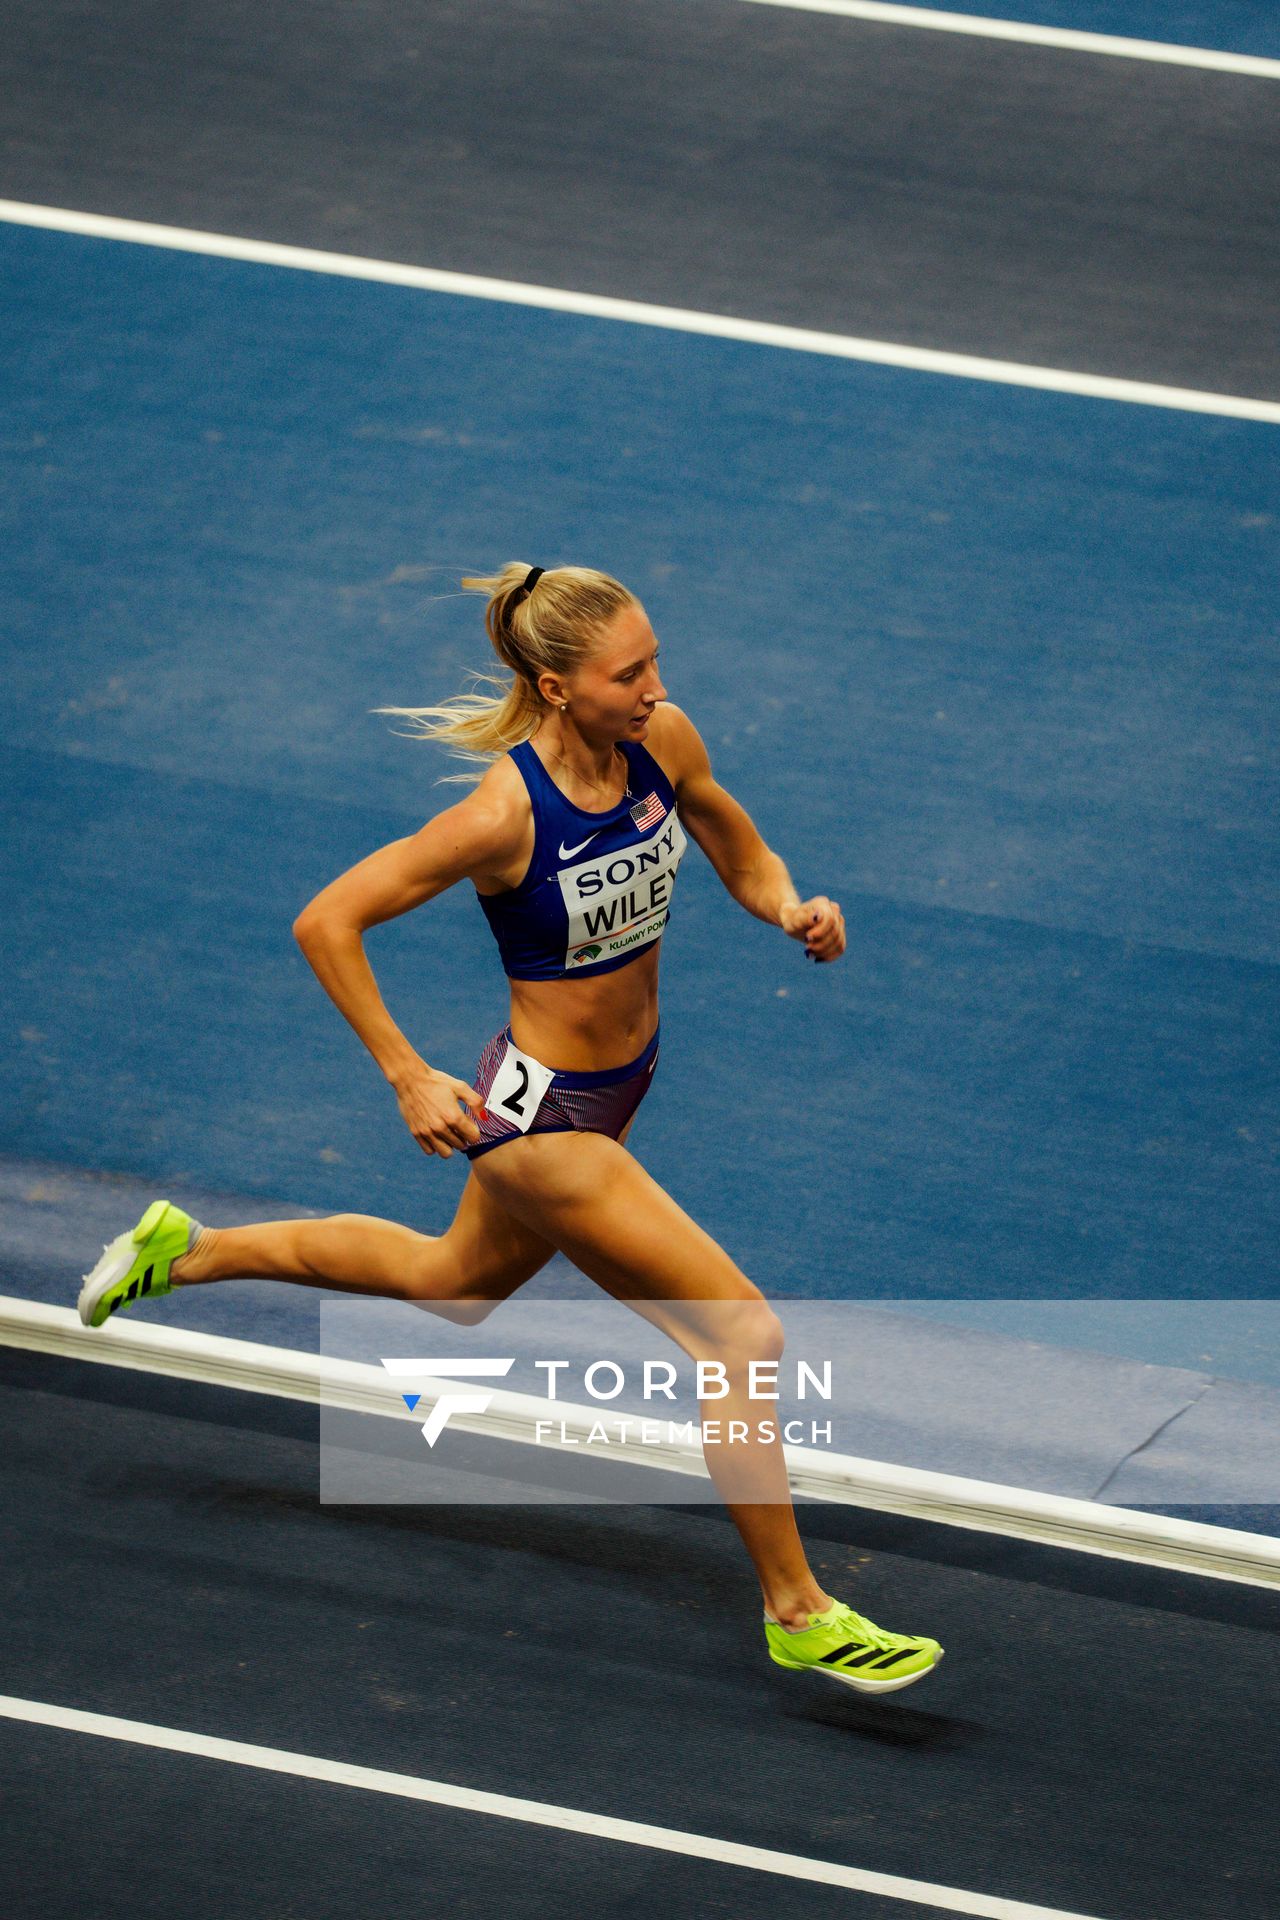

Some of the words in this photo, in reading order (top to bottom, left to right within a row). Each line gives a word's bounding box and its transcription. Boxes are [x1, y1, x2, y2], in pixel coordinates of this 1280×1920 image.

[576, 825, 675, 898] SONY
[609, 929, 646, 951] KUJAWY
[501, 1060, 529, 1117] 2
